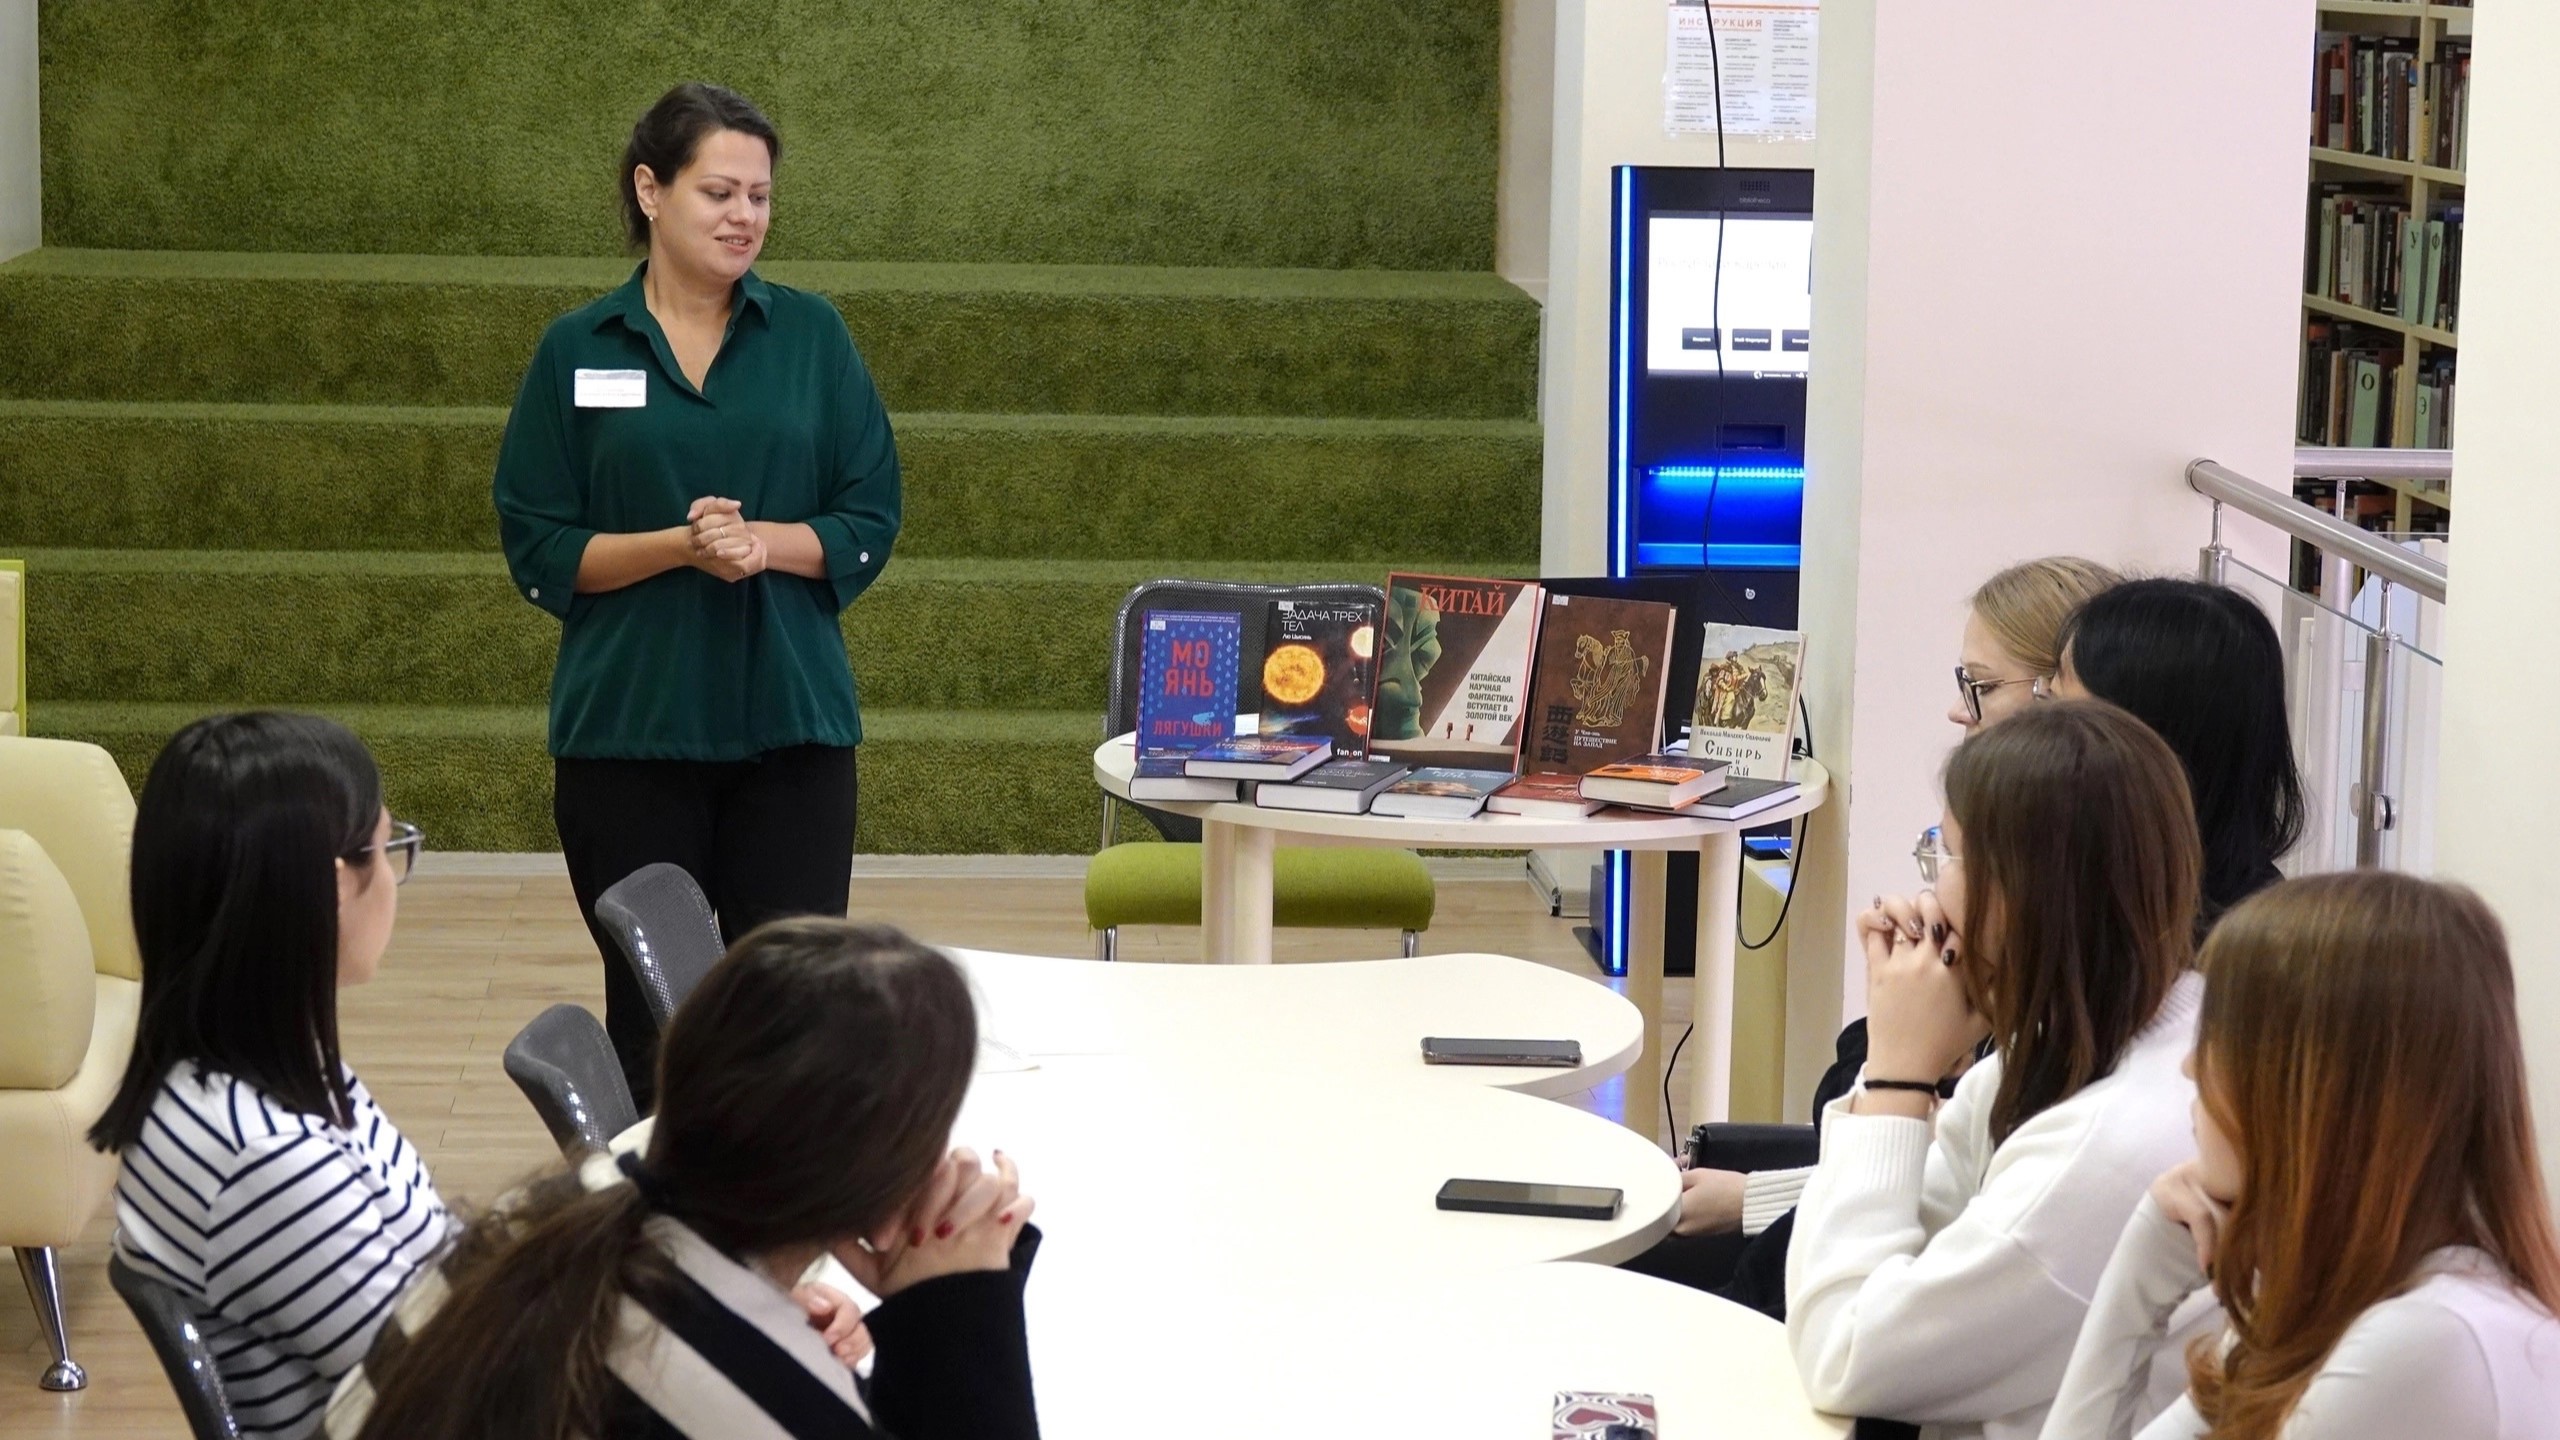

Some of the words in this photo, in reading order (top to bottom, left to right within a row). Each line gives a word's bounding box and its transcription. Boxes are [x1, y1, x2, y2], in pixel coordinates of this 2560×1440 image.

[1679, 17, 1762, 28] ИНСРУКЦИЯ
[2432, 231, 2441, 250] Ф
[2361, 373, 2375, 391] О
[1419, 582, 1507, 616] КИТАЙ
[1282, 608, 1331, 621] ЗАДАЧА
[1332, 610, 1363, 622] ТРЕХ
[1282, 620, 1305, 632] ТЕЛ
[1172, 640, 1210, 669] МО
[1165, 668, 1214, 697] ЯНЬ
[1470, 672, 1511, 683] КИТАЙСКАЯ
[1469, 682, 1501, 692] НАУЧНАЯ
[1468, 692, 1514, 703] ФАНТАСТИКА
[1467, 701, 1501, 712] ВСТУПАЕТ
[1503, 704, 1508, 712] В
[1465, 711, 1497, 721] ЗОЛОТОЙ
[1499, 713, 1513, 722] ВЕК
[1153, 720, 1223, 737] ЛЯГУШКИ
[1574, 735, 1618, 745] ПУТЕШЕСТВИЕ
